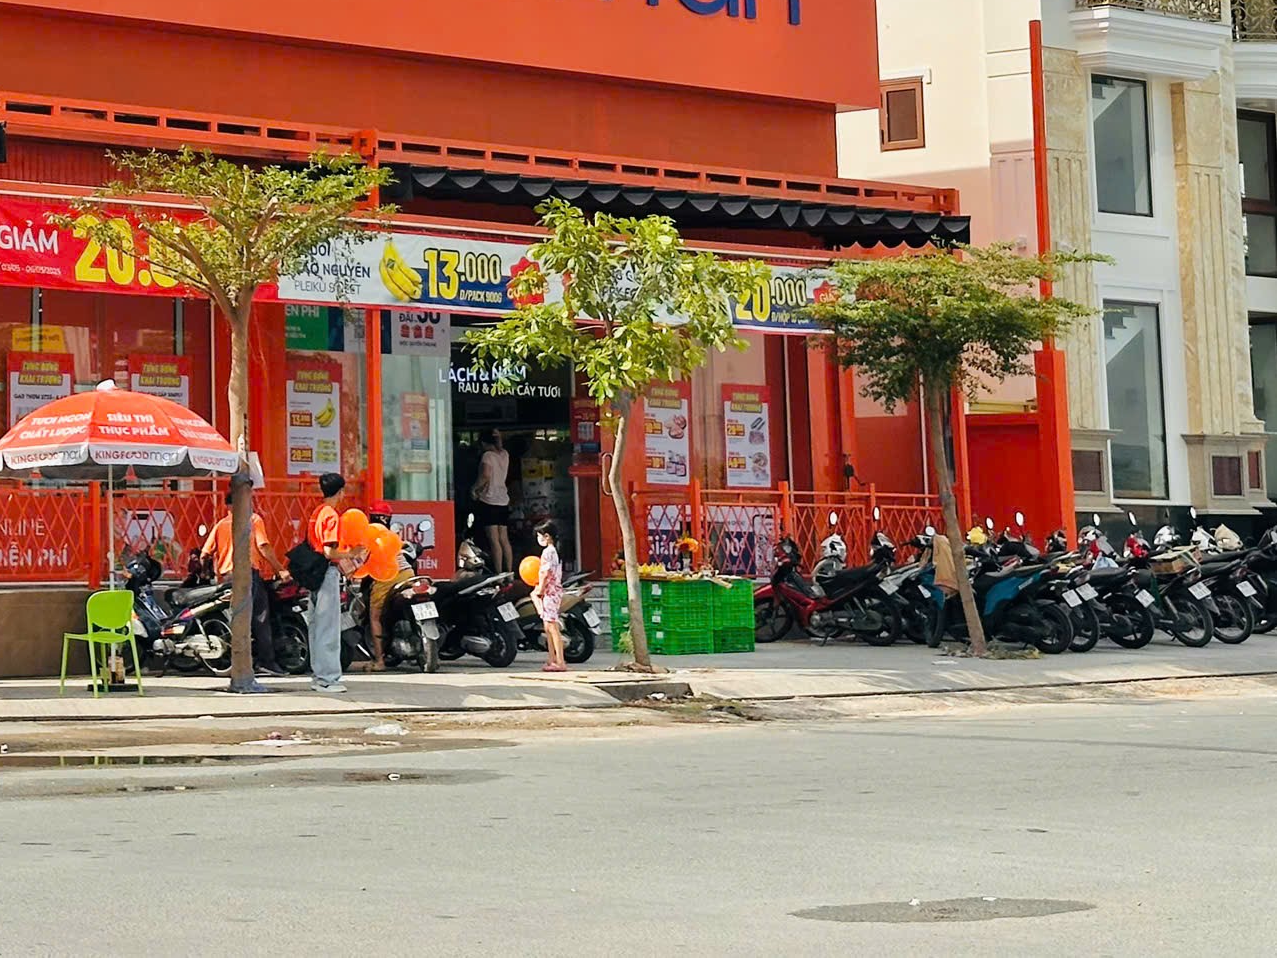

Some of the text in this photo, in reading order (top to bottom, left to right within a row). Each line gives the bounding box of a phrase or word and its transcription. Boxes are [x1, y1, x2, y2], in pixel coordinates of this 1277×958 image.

[322, 261, 372, 280] NGUYÊN
[294, 280, 327, 293] PLEIKU
[458, 382, 479, 394] RAU
[481, 383, 489, 394] &
[517, 382, 536, 397] CÂY
[537, 384, 561, 398] TƯƠI
[107, 413, 132, 423] SIÊU
[131, 424, 170, 436] PHẨM
[38, 543, 68, 567] PHÍ
